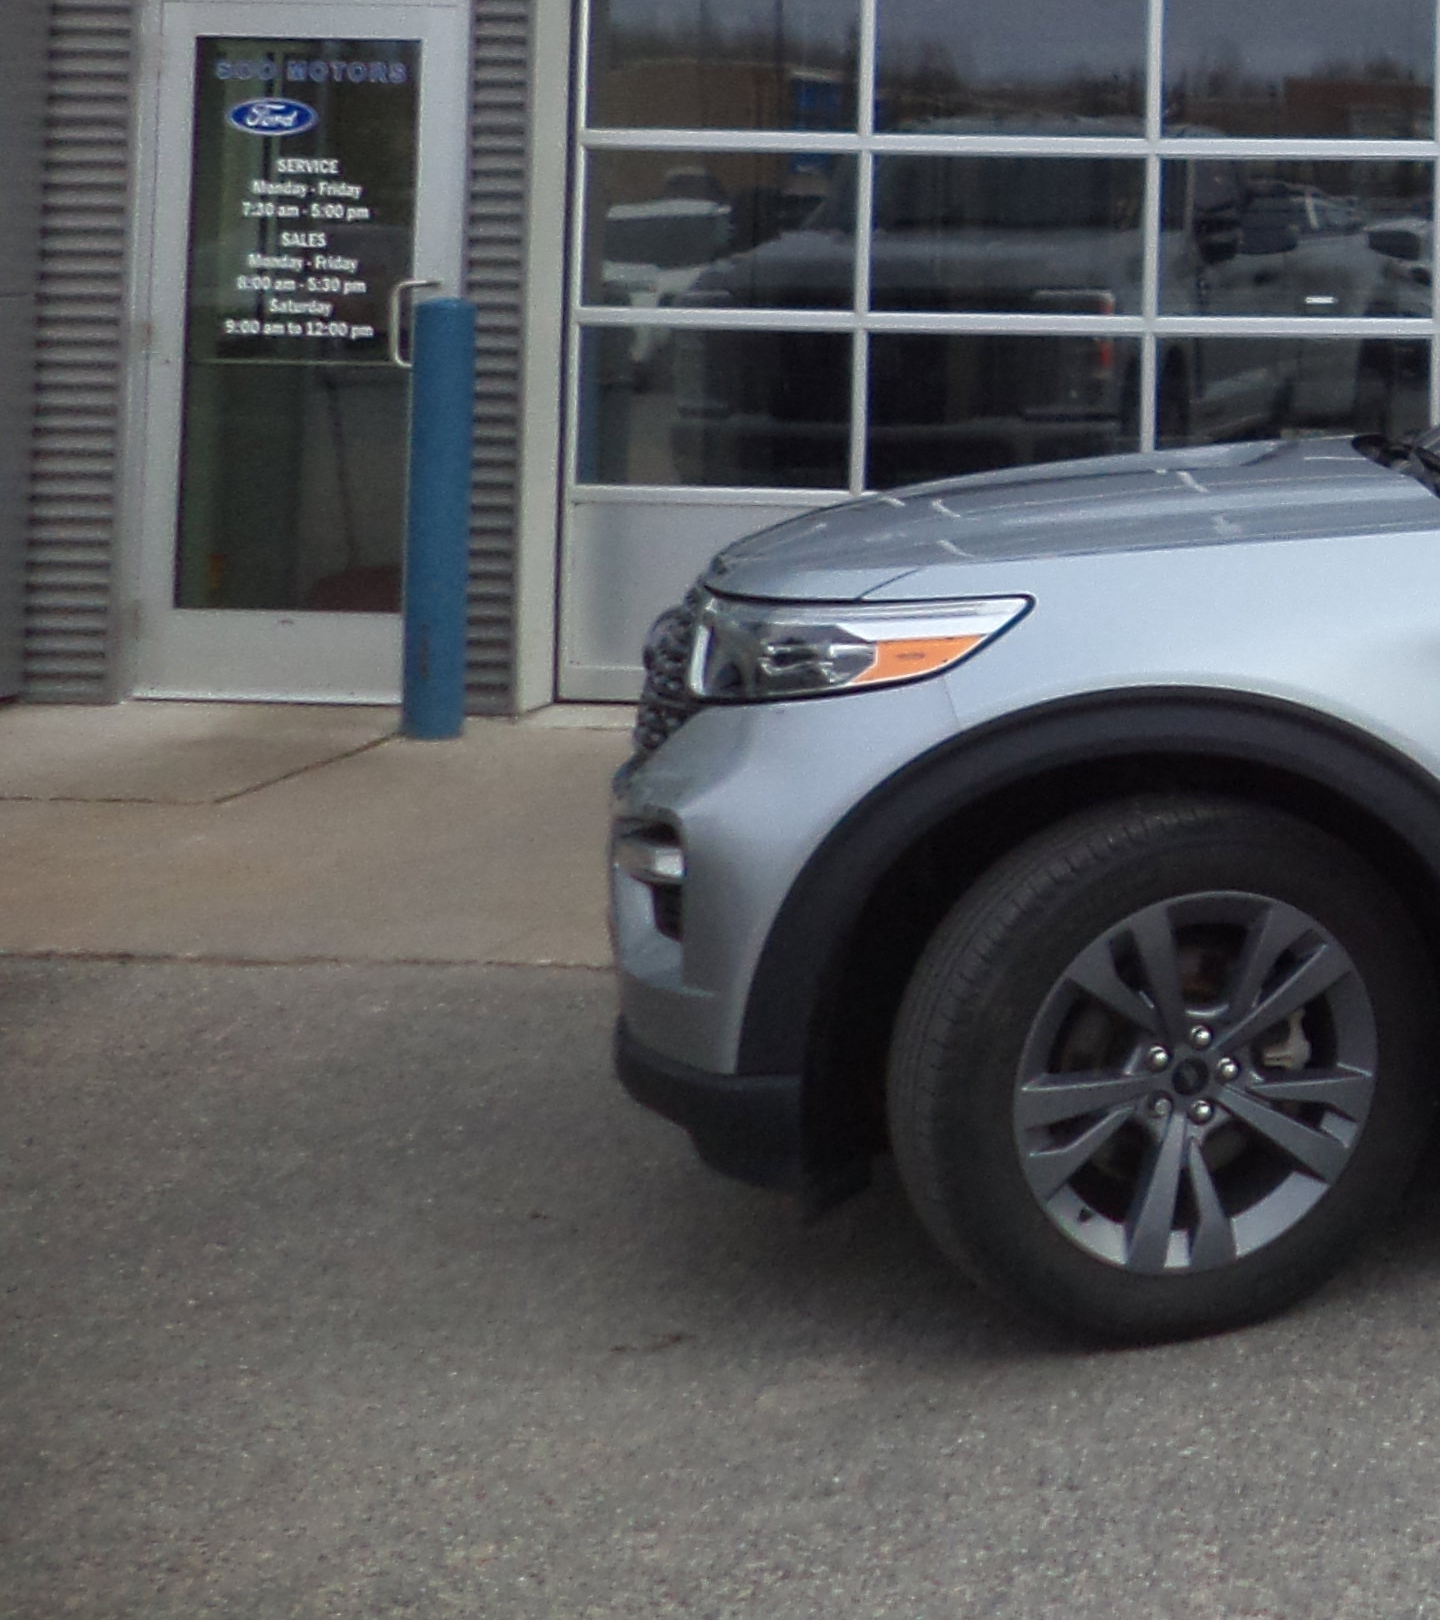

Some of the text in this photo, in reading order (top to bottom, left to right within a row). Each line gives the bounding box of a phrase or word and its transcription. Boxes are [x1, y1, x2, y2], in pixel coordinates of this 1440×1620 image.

[216, 60, 407, 83] SOO MOTORS
[246, 104, 298, 127] Ford
[276, 158, 339, 174] SERVICE
[252, 180, 307, 198] Monday
[318, 182, 362, 199] Friday
[242, 202, 274, 216] 7:30
[278, 205, 300, 217] am
[311, 203, 344, 218] 5:00
[346, 206, 370, 221] pm
[281, 232, 327, 248] SALES
[248, 253, 304, 272] Monday
[315, 255, 358, 273] Friday
[274, 280, 296, 291] am
[307, 277, 340, 292] 5:30
[343, 281, 366, 295] pm
[269, 298, 333, 317] Saturday
[263, 324, 285, 335] am
[287, 322, 303, 335] to
[306, 322, 347, 336] 12:00
[350, 325, 374, 340] pm
